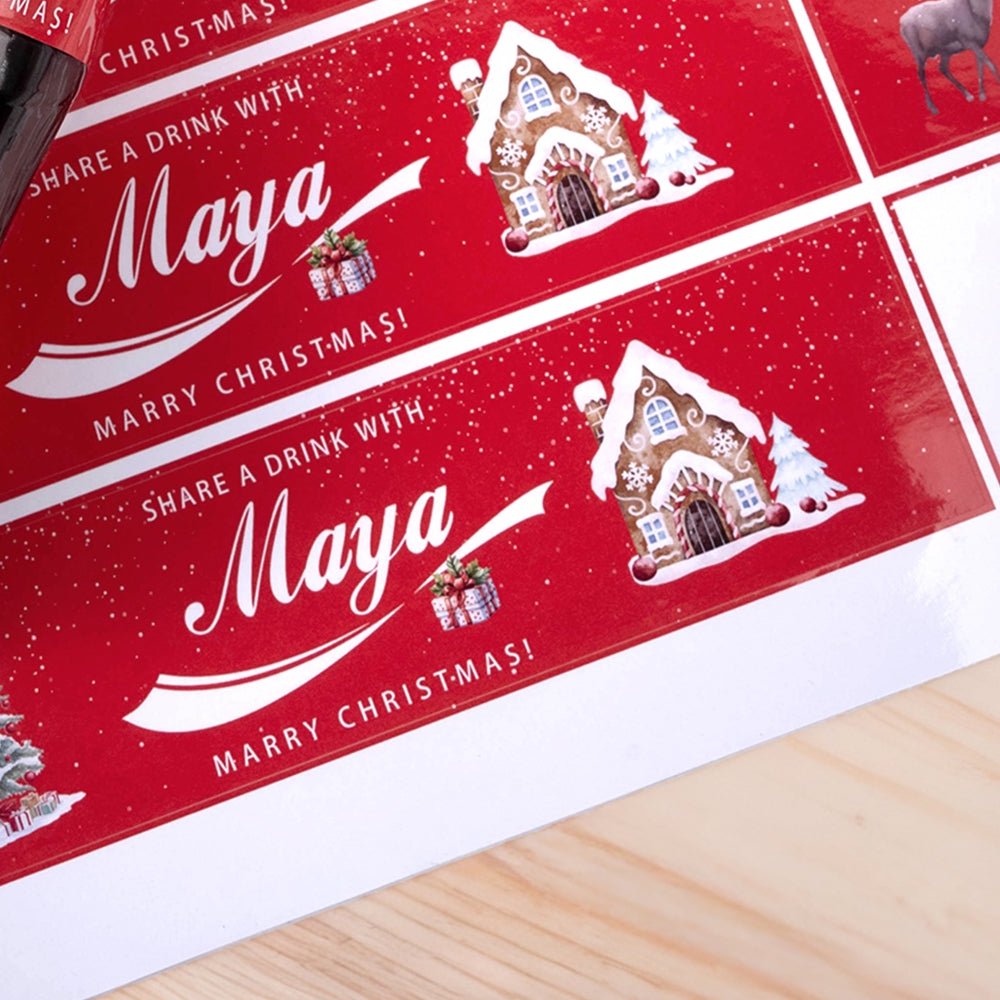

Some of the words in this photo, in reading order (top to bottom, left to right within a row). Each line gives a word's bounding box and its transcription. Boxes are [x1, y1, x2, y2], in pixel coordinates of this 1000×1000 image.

[122, 140, 138, 163] A
[145, 105, 229, 153] DRINK
[234, 79, 304, 120] WITH
[66, 160, 332, 306] Maya
[92, 383, 198, 442] MARRY
[215, 307, 408, 395] CHRISTMAS!
[141, 471, 230, 523] SHARE
[240, 463, 257, 487] A
[263, 427, 349, 477] DRINK
[353, 399, 426, 442] WITH
[184, 484, 454, 636] Maya
[212, 717, 319, 778] MARRY
[337, 637, 534, 729] CHRISTMAS!
